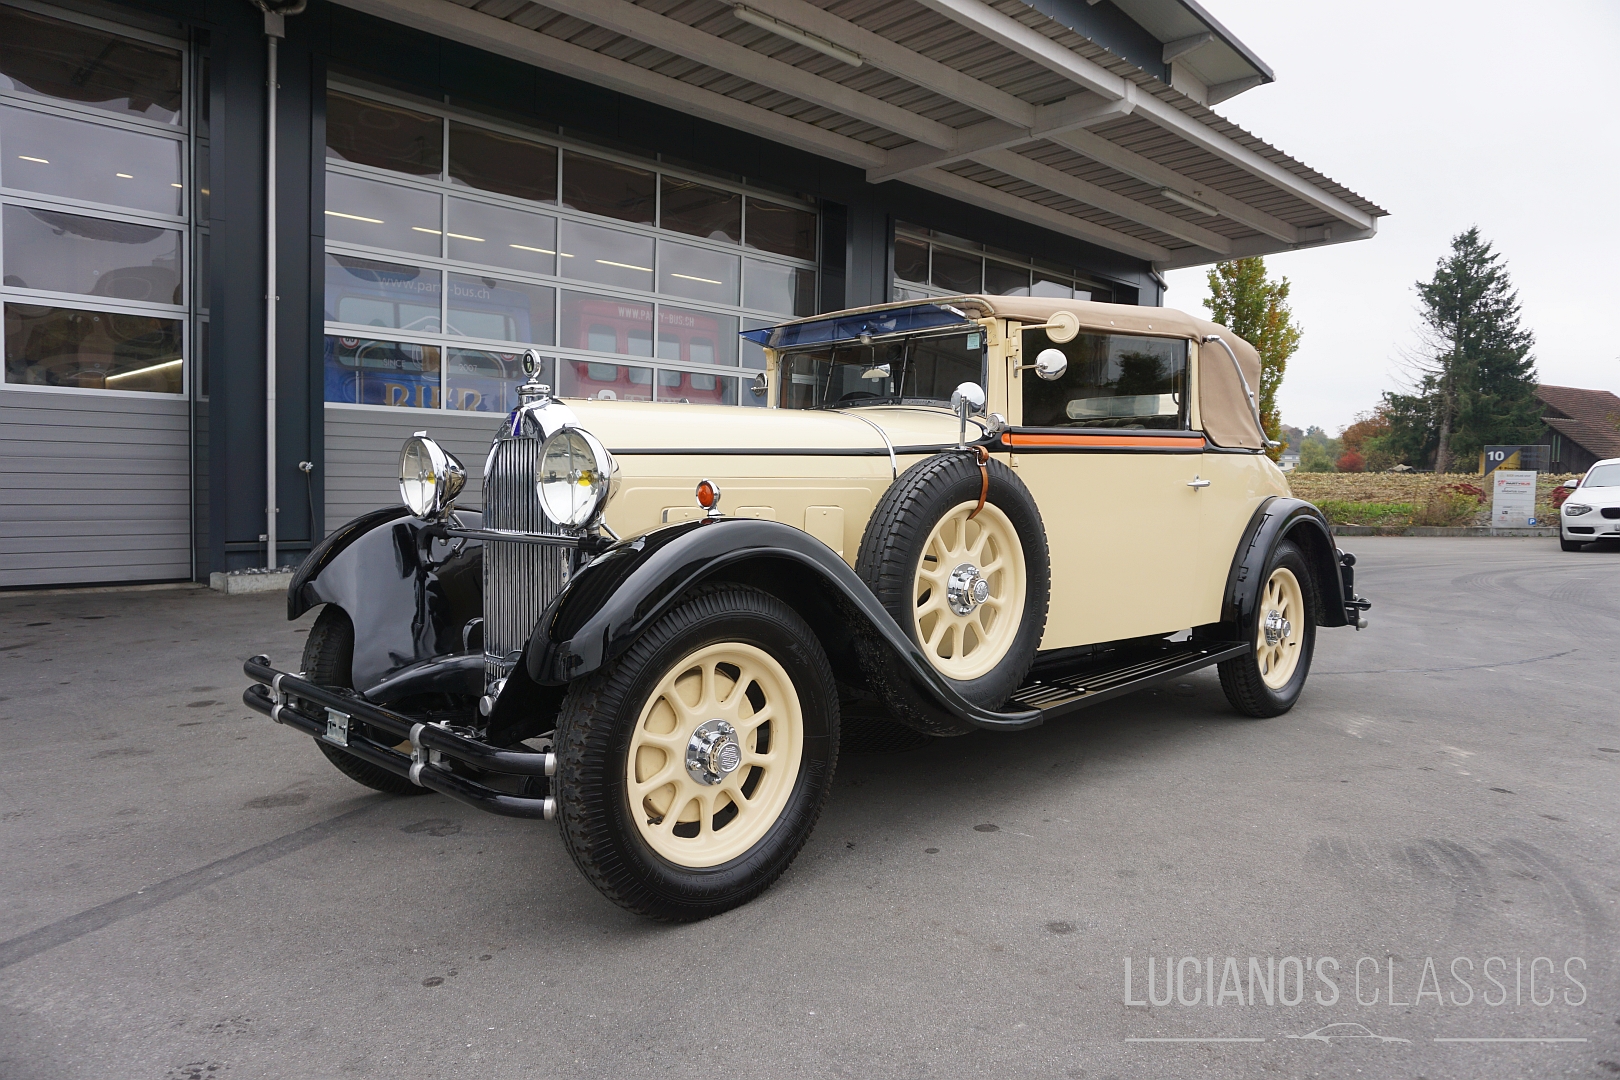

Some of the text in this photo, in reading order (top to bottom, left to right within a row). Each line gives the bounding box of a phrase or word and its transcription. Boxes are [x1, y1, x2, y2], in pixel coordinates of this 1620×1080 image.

[380, 277, 490, 300] www.par-bus.ch
[383, 358, 406, 368] SINCE
[1487, 451, 1505, 461] 10
[746, 758, 827, 879] MICHELIN
